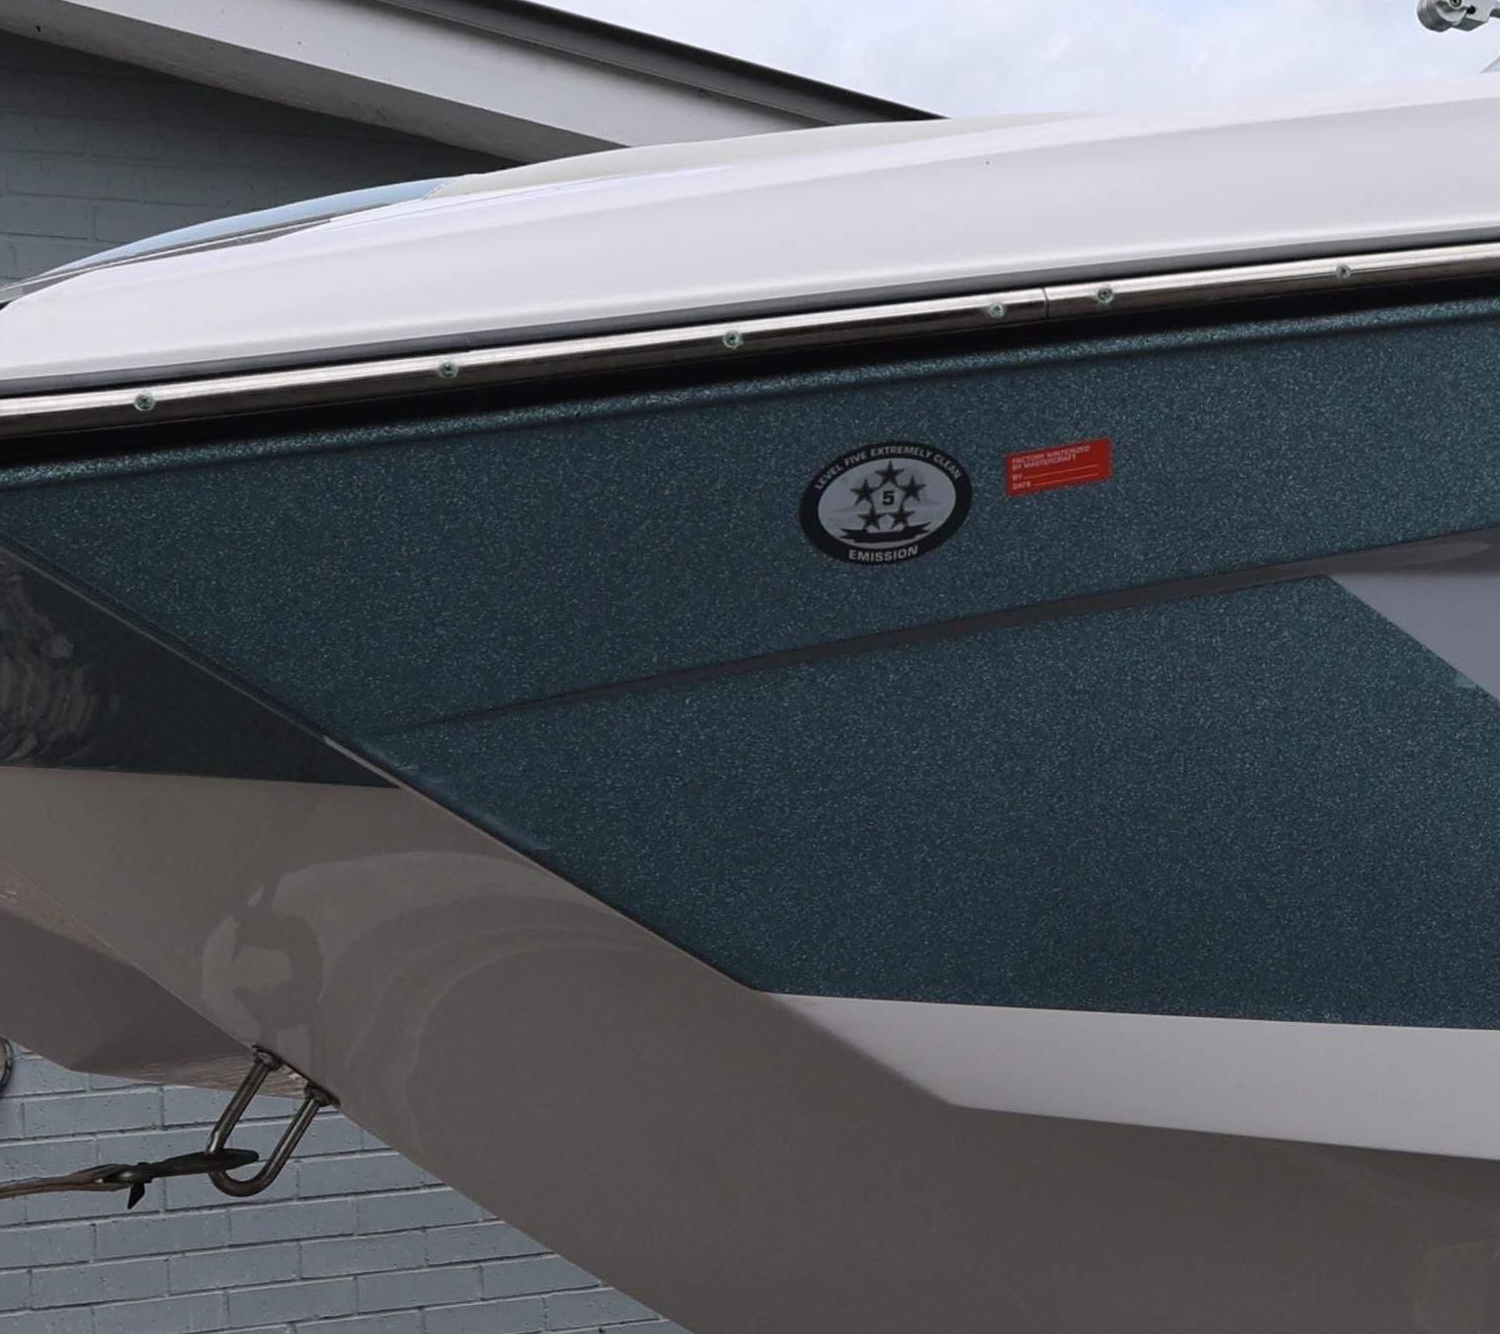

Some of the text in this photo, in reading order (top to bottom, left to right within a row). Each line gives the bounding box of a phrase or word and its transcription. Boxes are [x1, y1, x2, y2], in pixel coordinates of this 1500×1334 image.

[815, 446, 962, 490] LEVEL FIVE EXTREMELY CLEAN
[882, 490, 895, 506] 5
[849, 545, 919, 562] EMISSION
